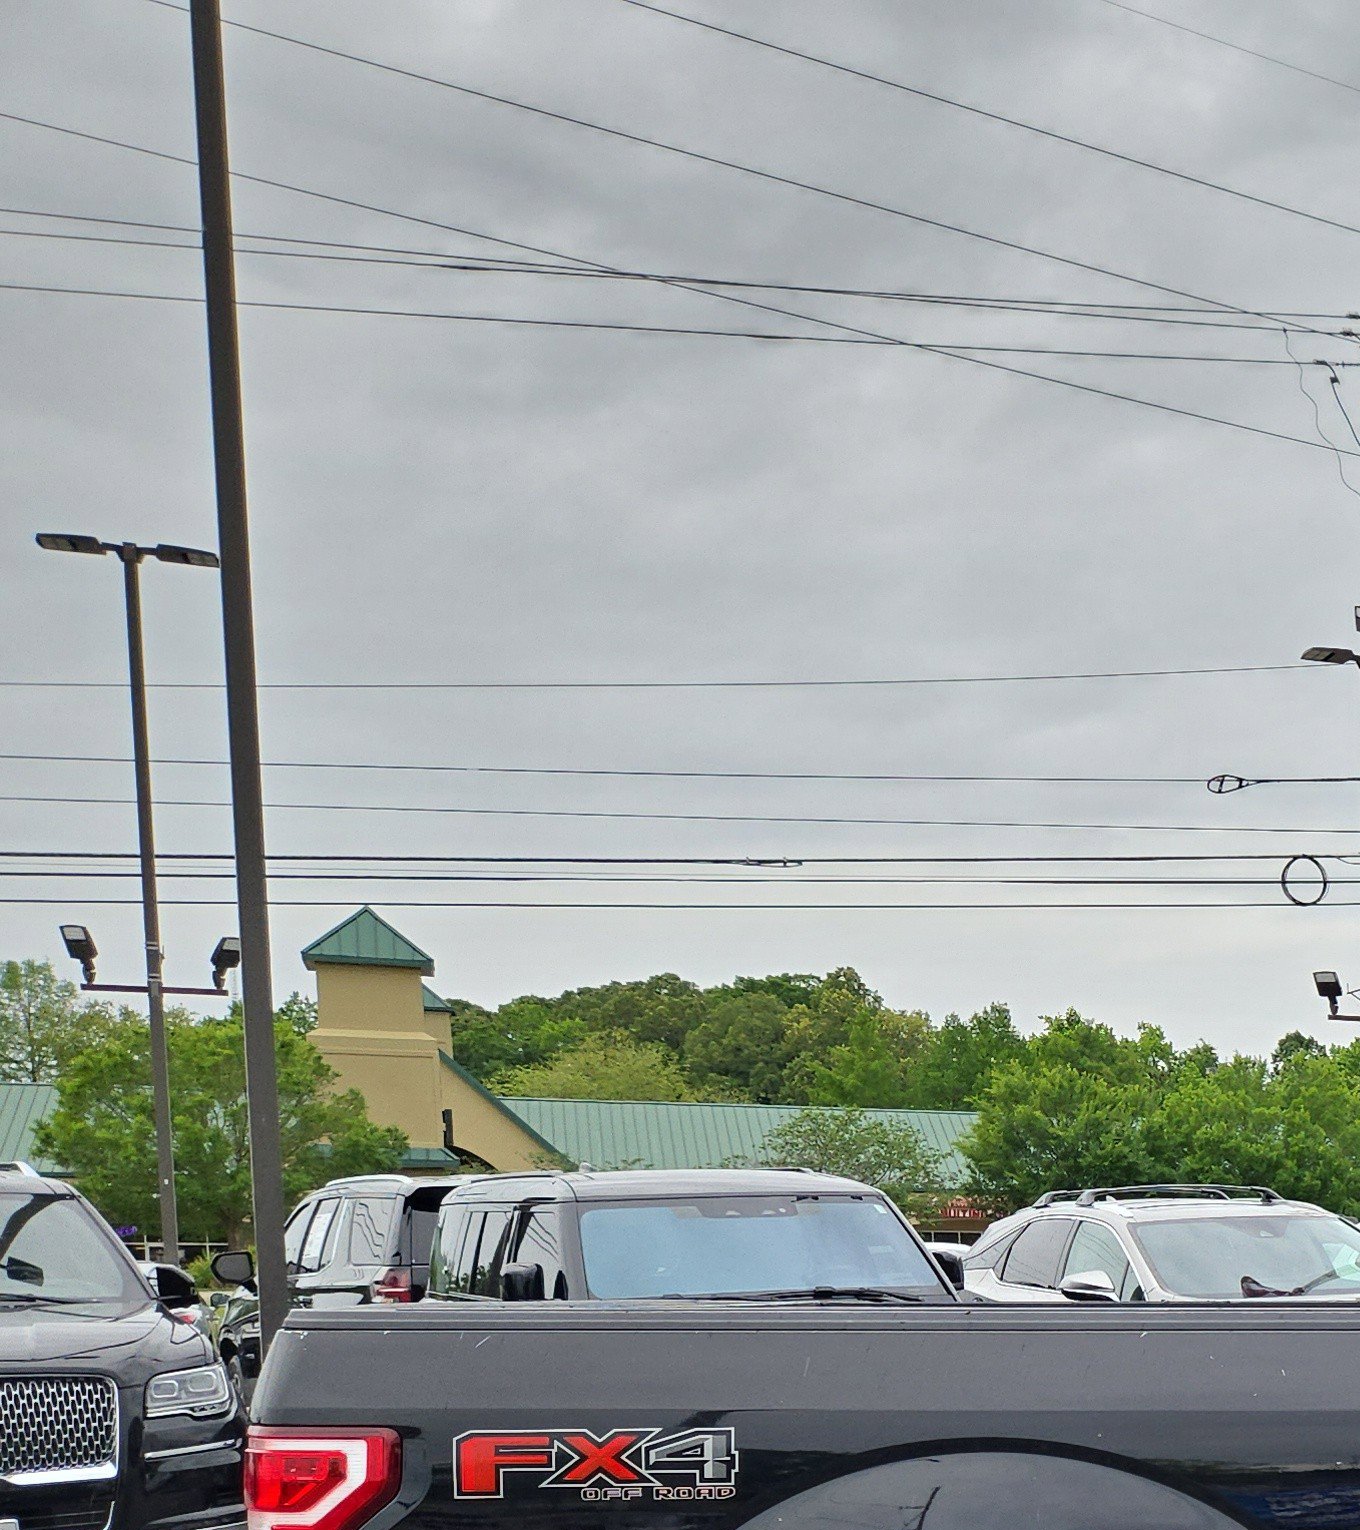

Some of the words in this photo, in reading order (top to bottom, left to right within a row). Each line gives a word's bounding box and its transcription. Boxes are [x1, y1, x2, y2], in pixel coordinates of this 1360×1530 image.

[453, 1427, 739, 1499] FX4
[580, 1487, 644, 1501] OFF
[653, 1486, 737, 1501] ROAD
